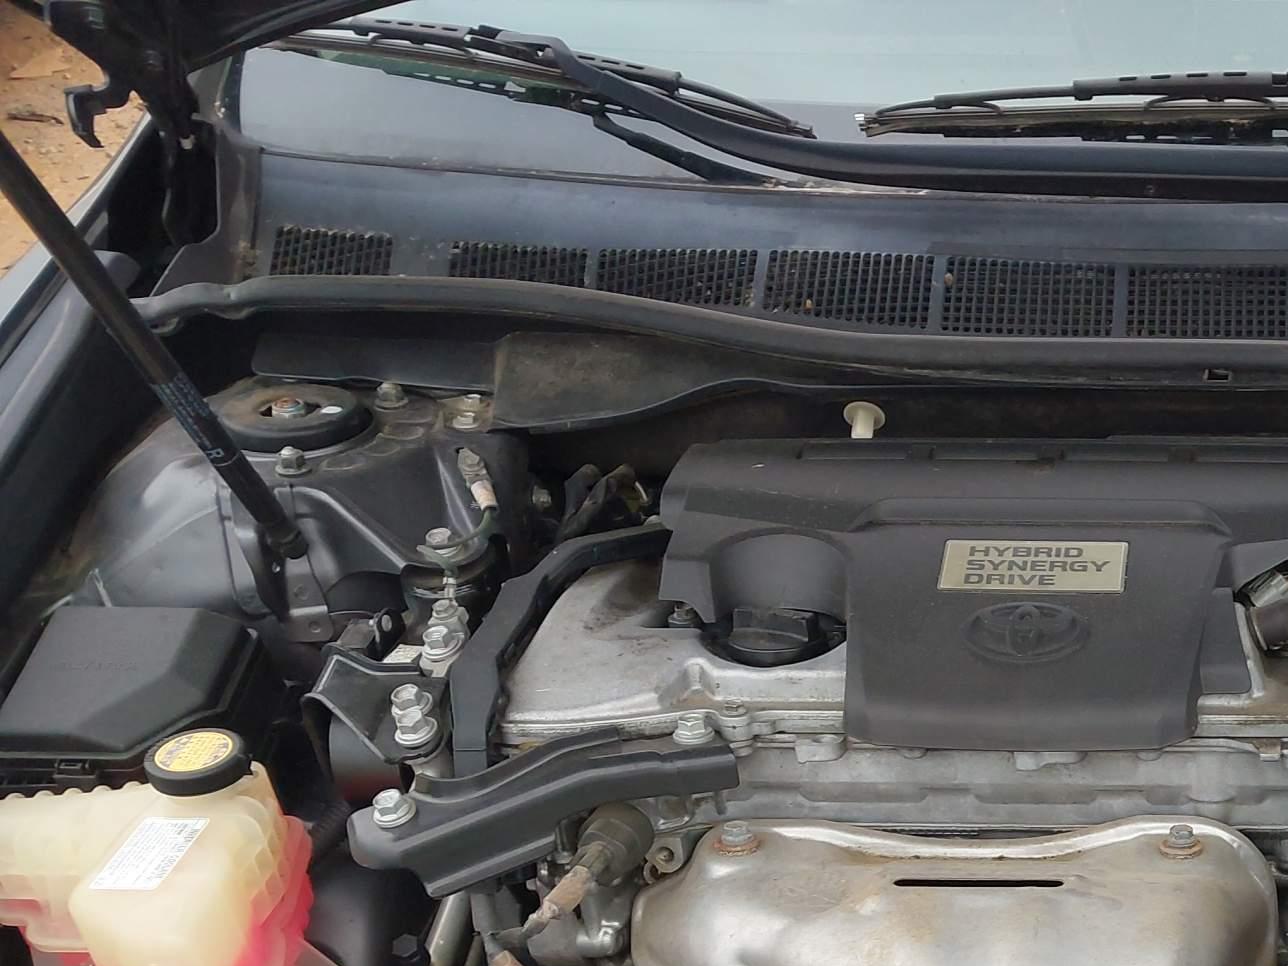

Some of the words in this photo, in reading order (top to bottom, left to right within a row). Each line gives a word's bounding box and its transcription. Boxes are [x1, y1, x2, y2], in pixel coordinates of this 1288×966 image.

[968, 545, 1084, 558] HYBRID
[965, 559, 1110, 572] SYNERGY
[963, 573, 1056, 586] DRIVE
